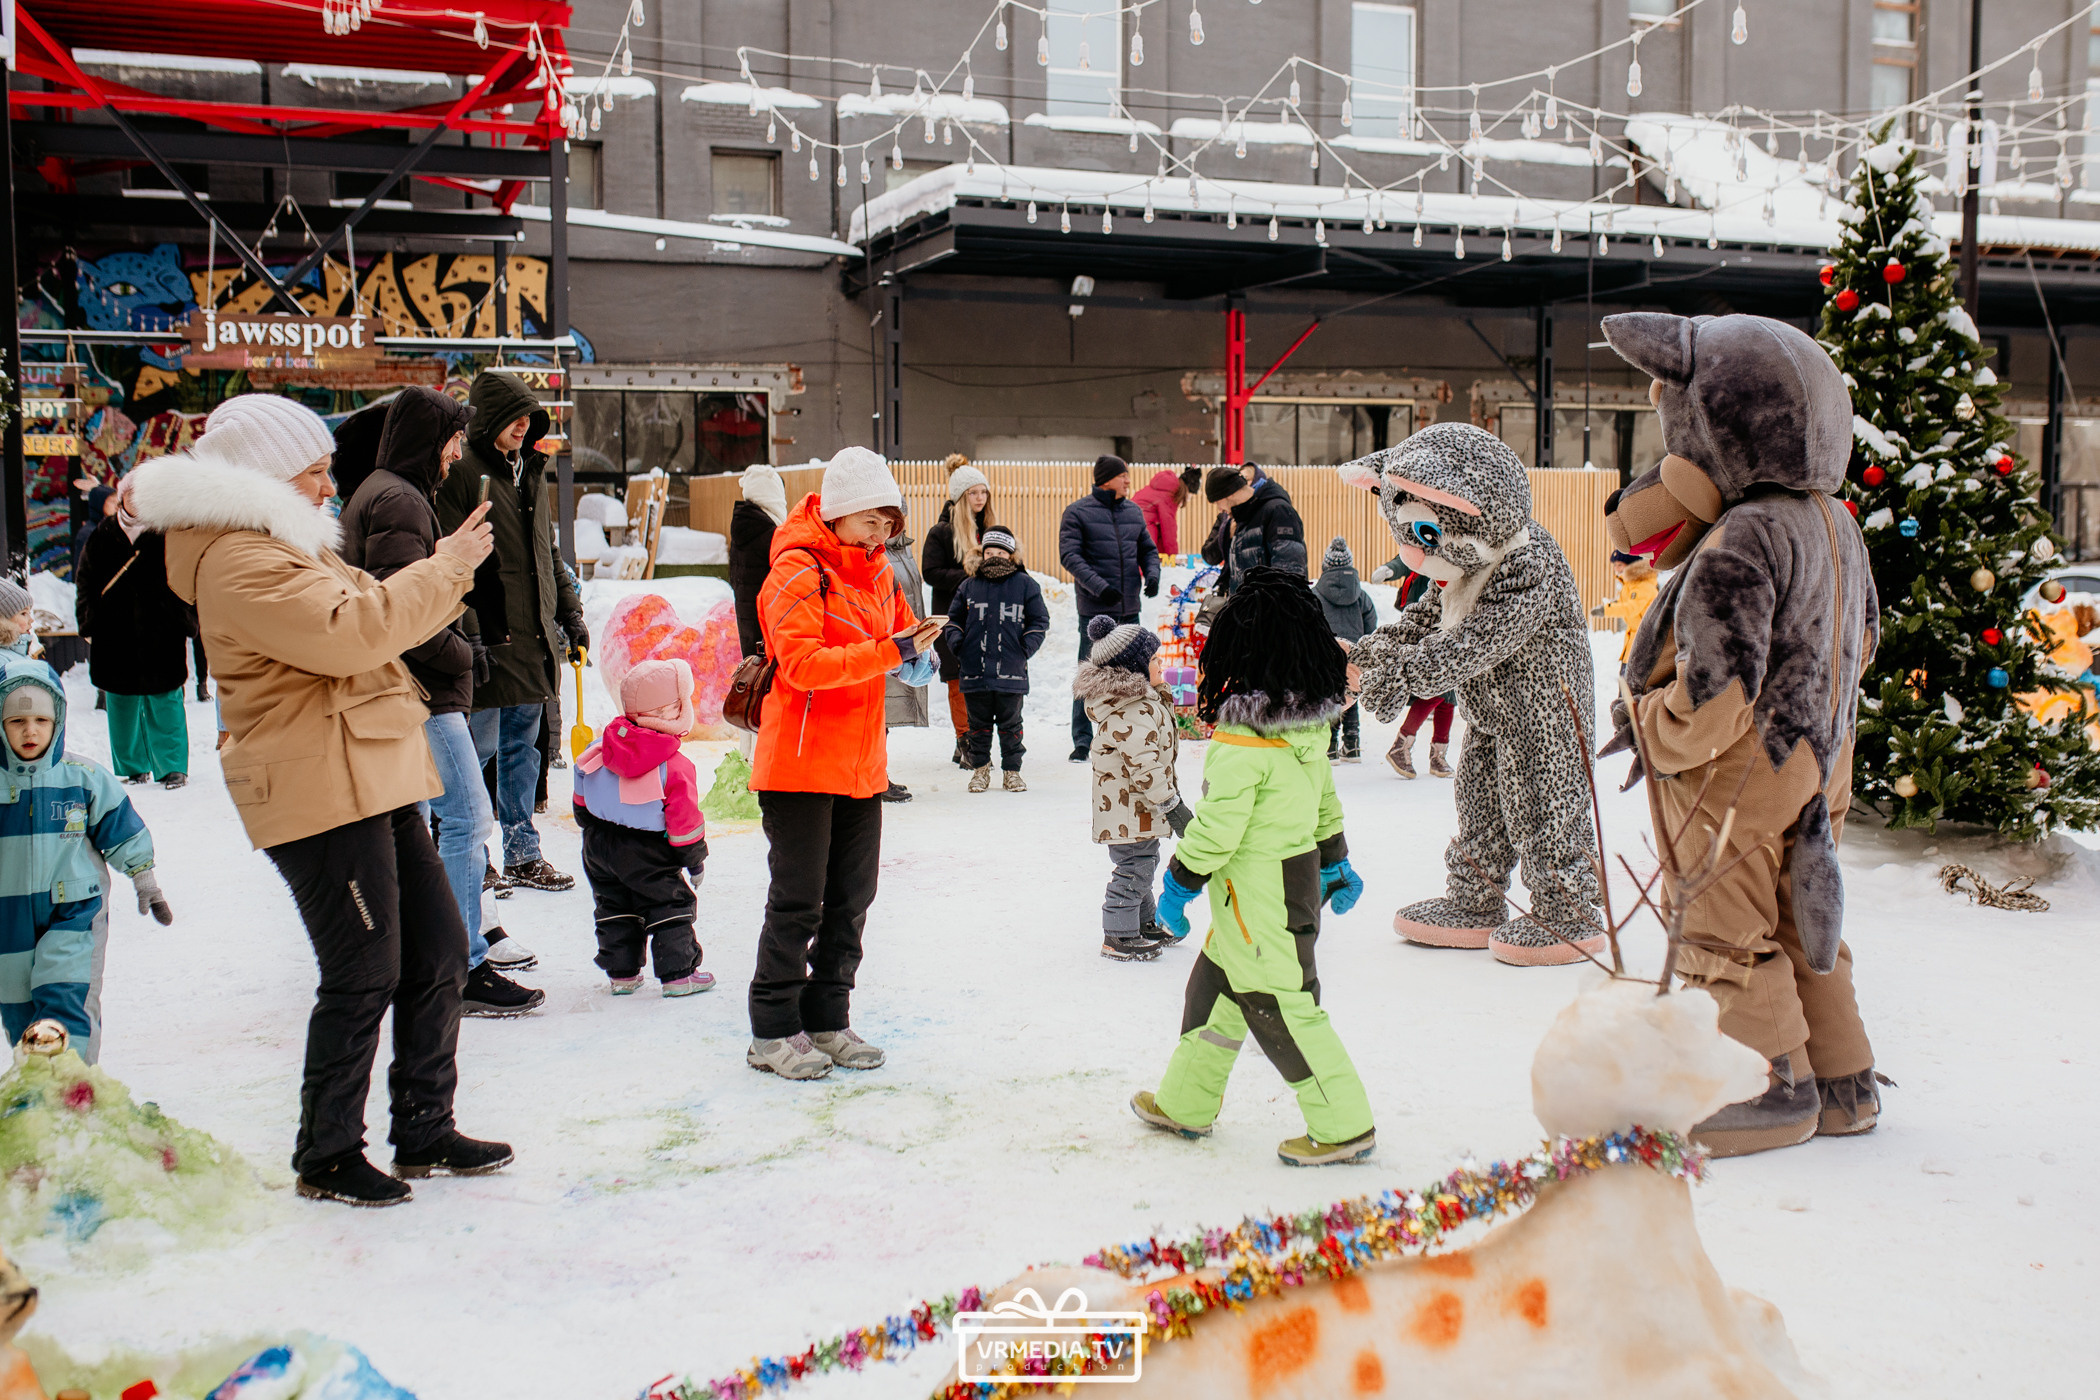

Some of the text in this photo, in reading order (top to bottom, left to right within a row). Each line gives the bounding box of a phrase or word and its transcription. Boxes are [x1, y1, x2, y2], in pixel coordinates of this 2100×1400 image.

[202, 313, 365, 356] jawsspot
[244, 349, 324, 370] beer's beach
[348, 880, 377, 930] SALOMON
